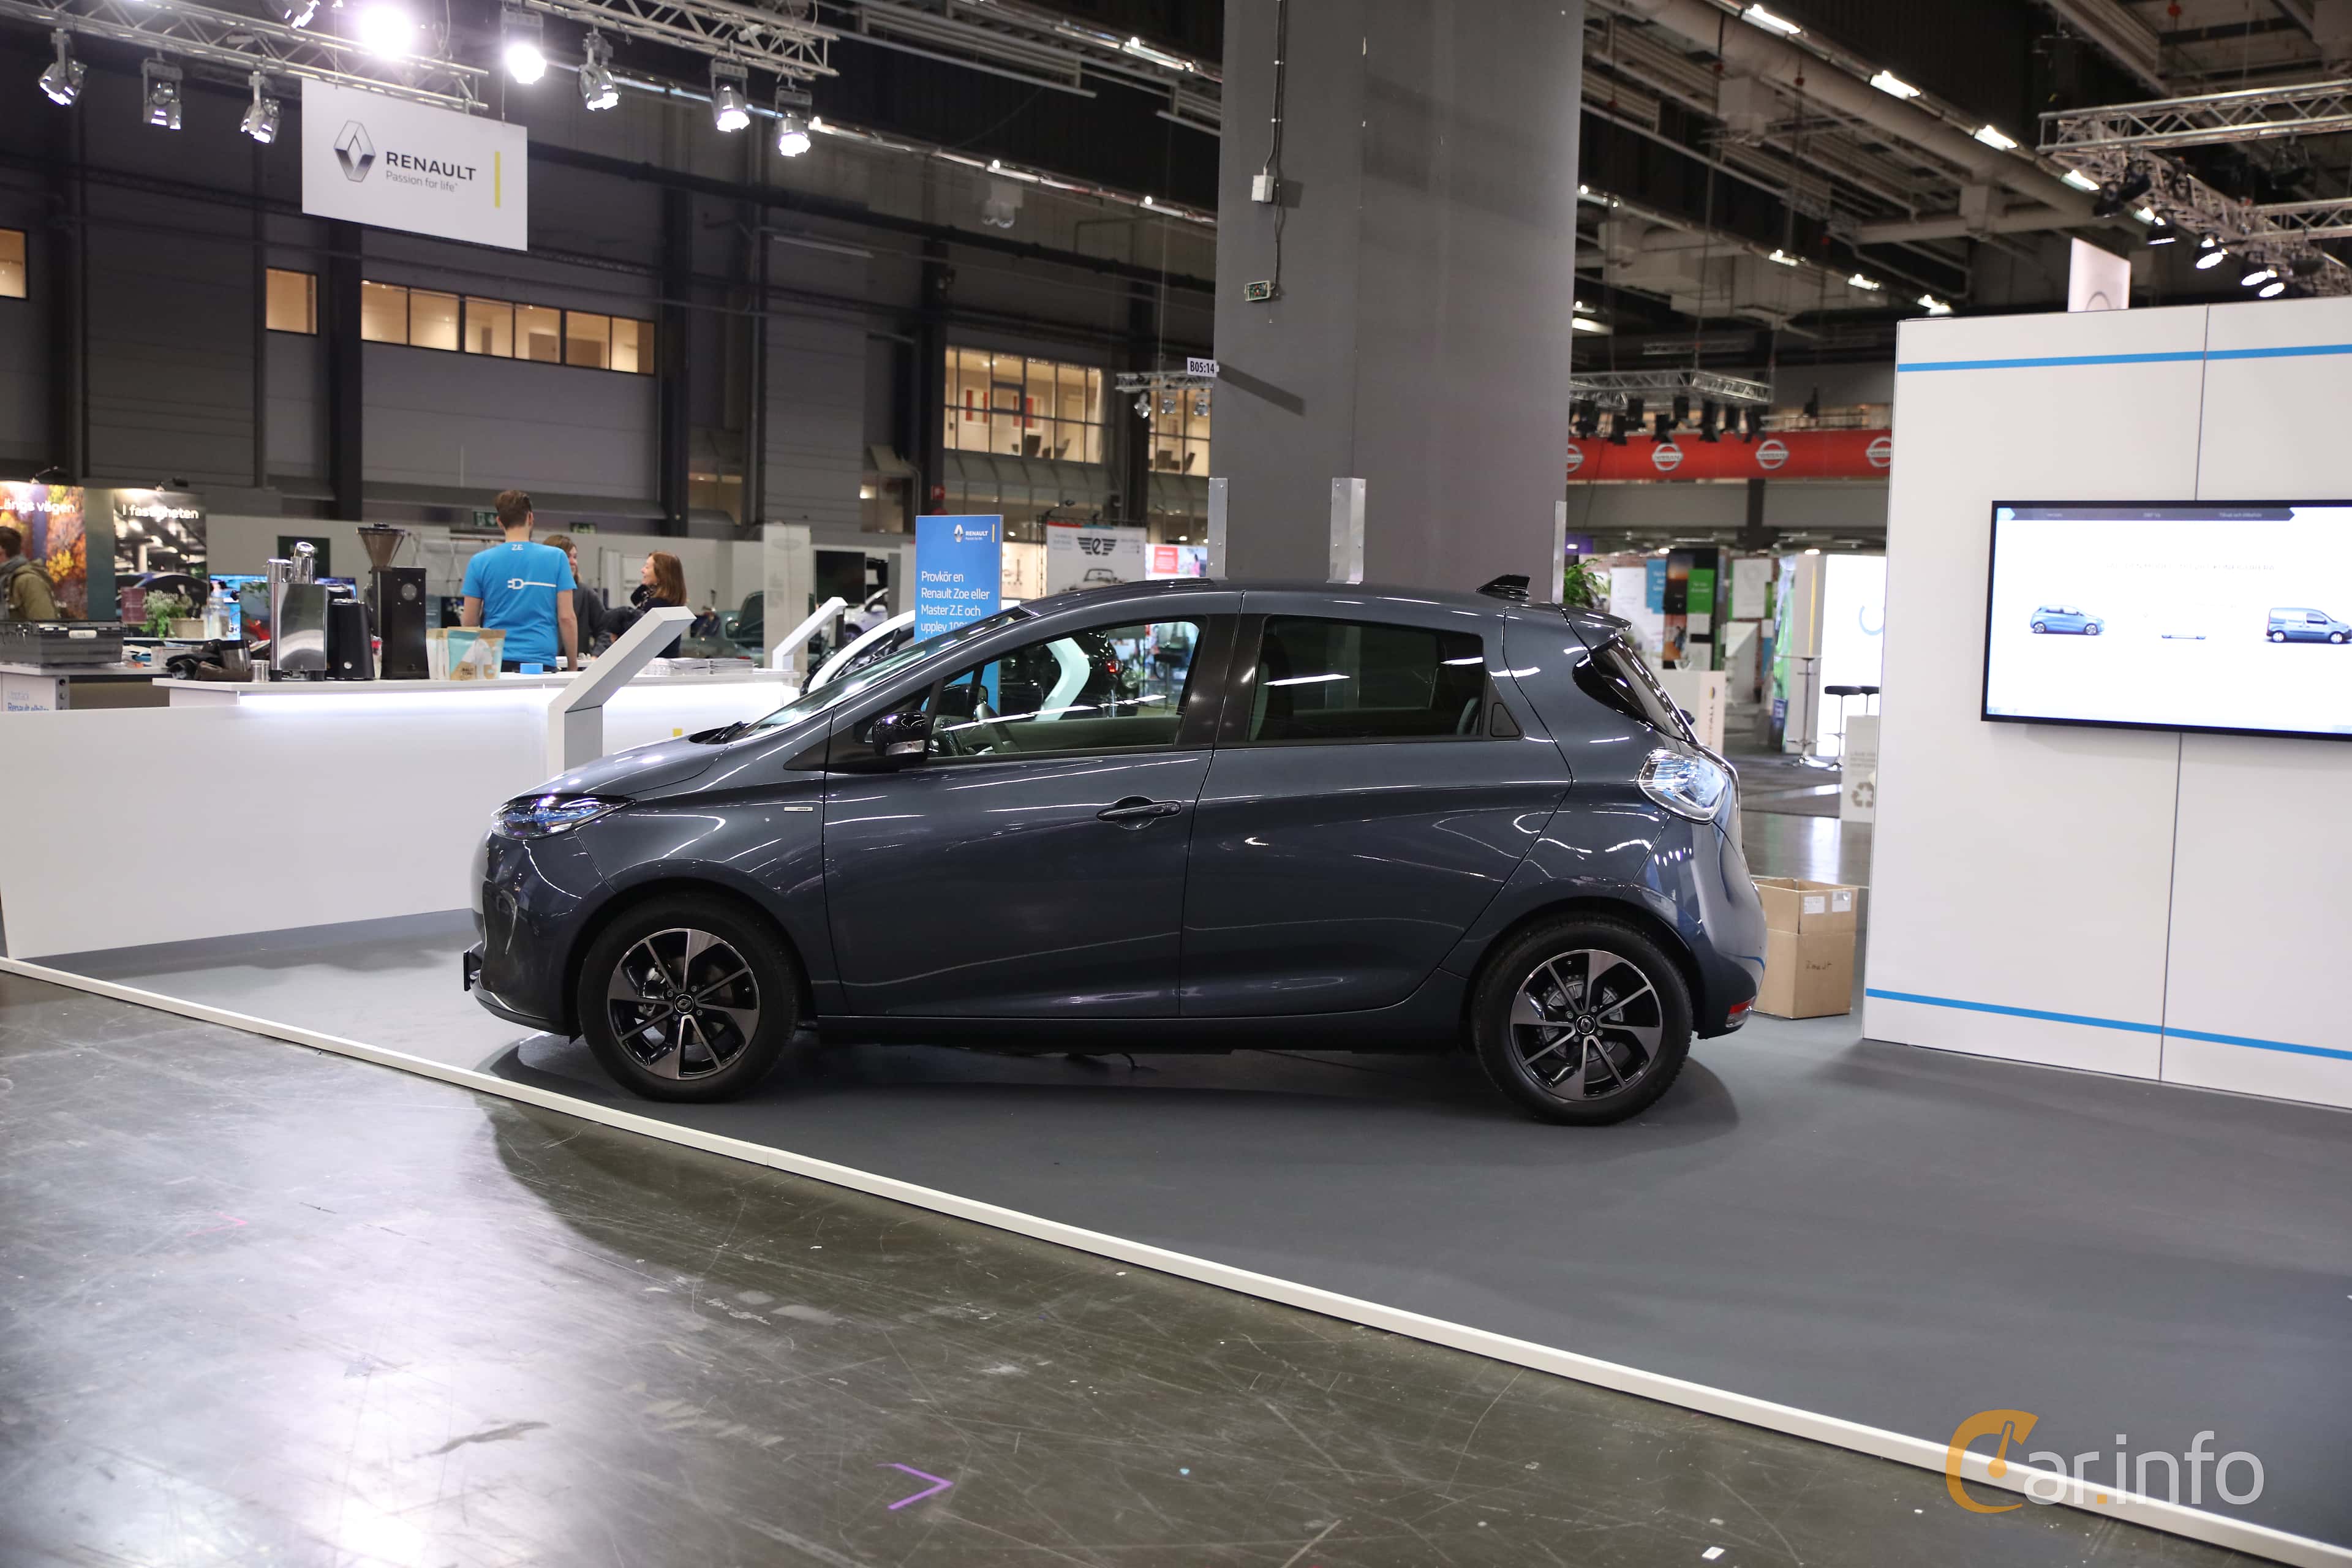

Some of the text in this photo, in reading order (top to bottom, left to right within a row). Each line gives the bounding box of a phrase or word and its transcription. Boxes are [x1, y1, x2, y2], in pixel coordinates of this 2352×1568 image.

[386, 151, 477, 181] RENAULT
[386, 171, 423, 186] Passion
[425, 177, 438, 189] for
[1190, 361, 1215, 374] B05:14
[37, 500, 75, 515] vägen
[123, 503, 127, 516] I
[921, 571, 964, 582] Provkör en
[921, 587, 990, 600] Renault Zoe eller
[921, 604, 981, 616] Master Z.E och
[921, 620, 947, 635] upplev
